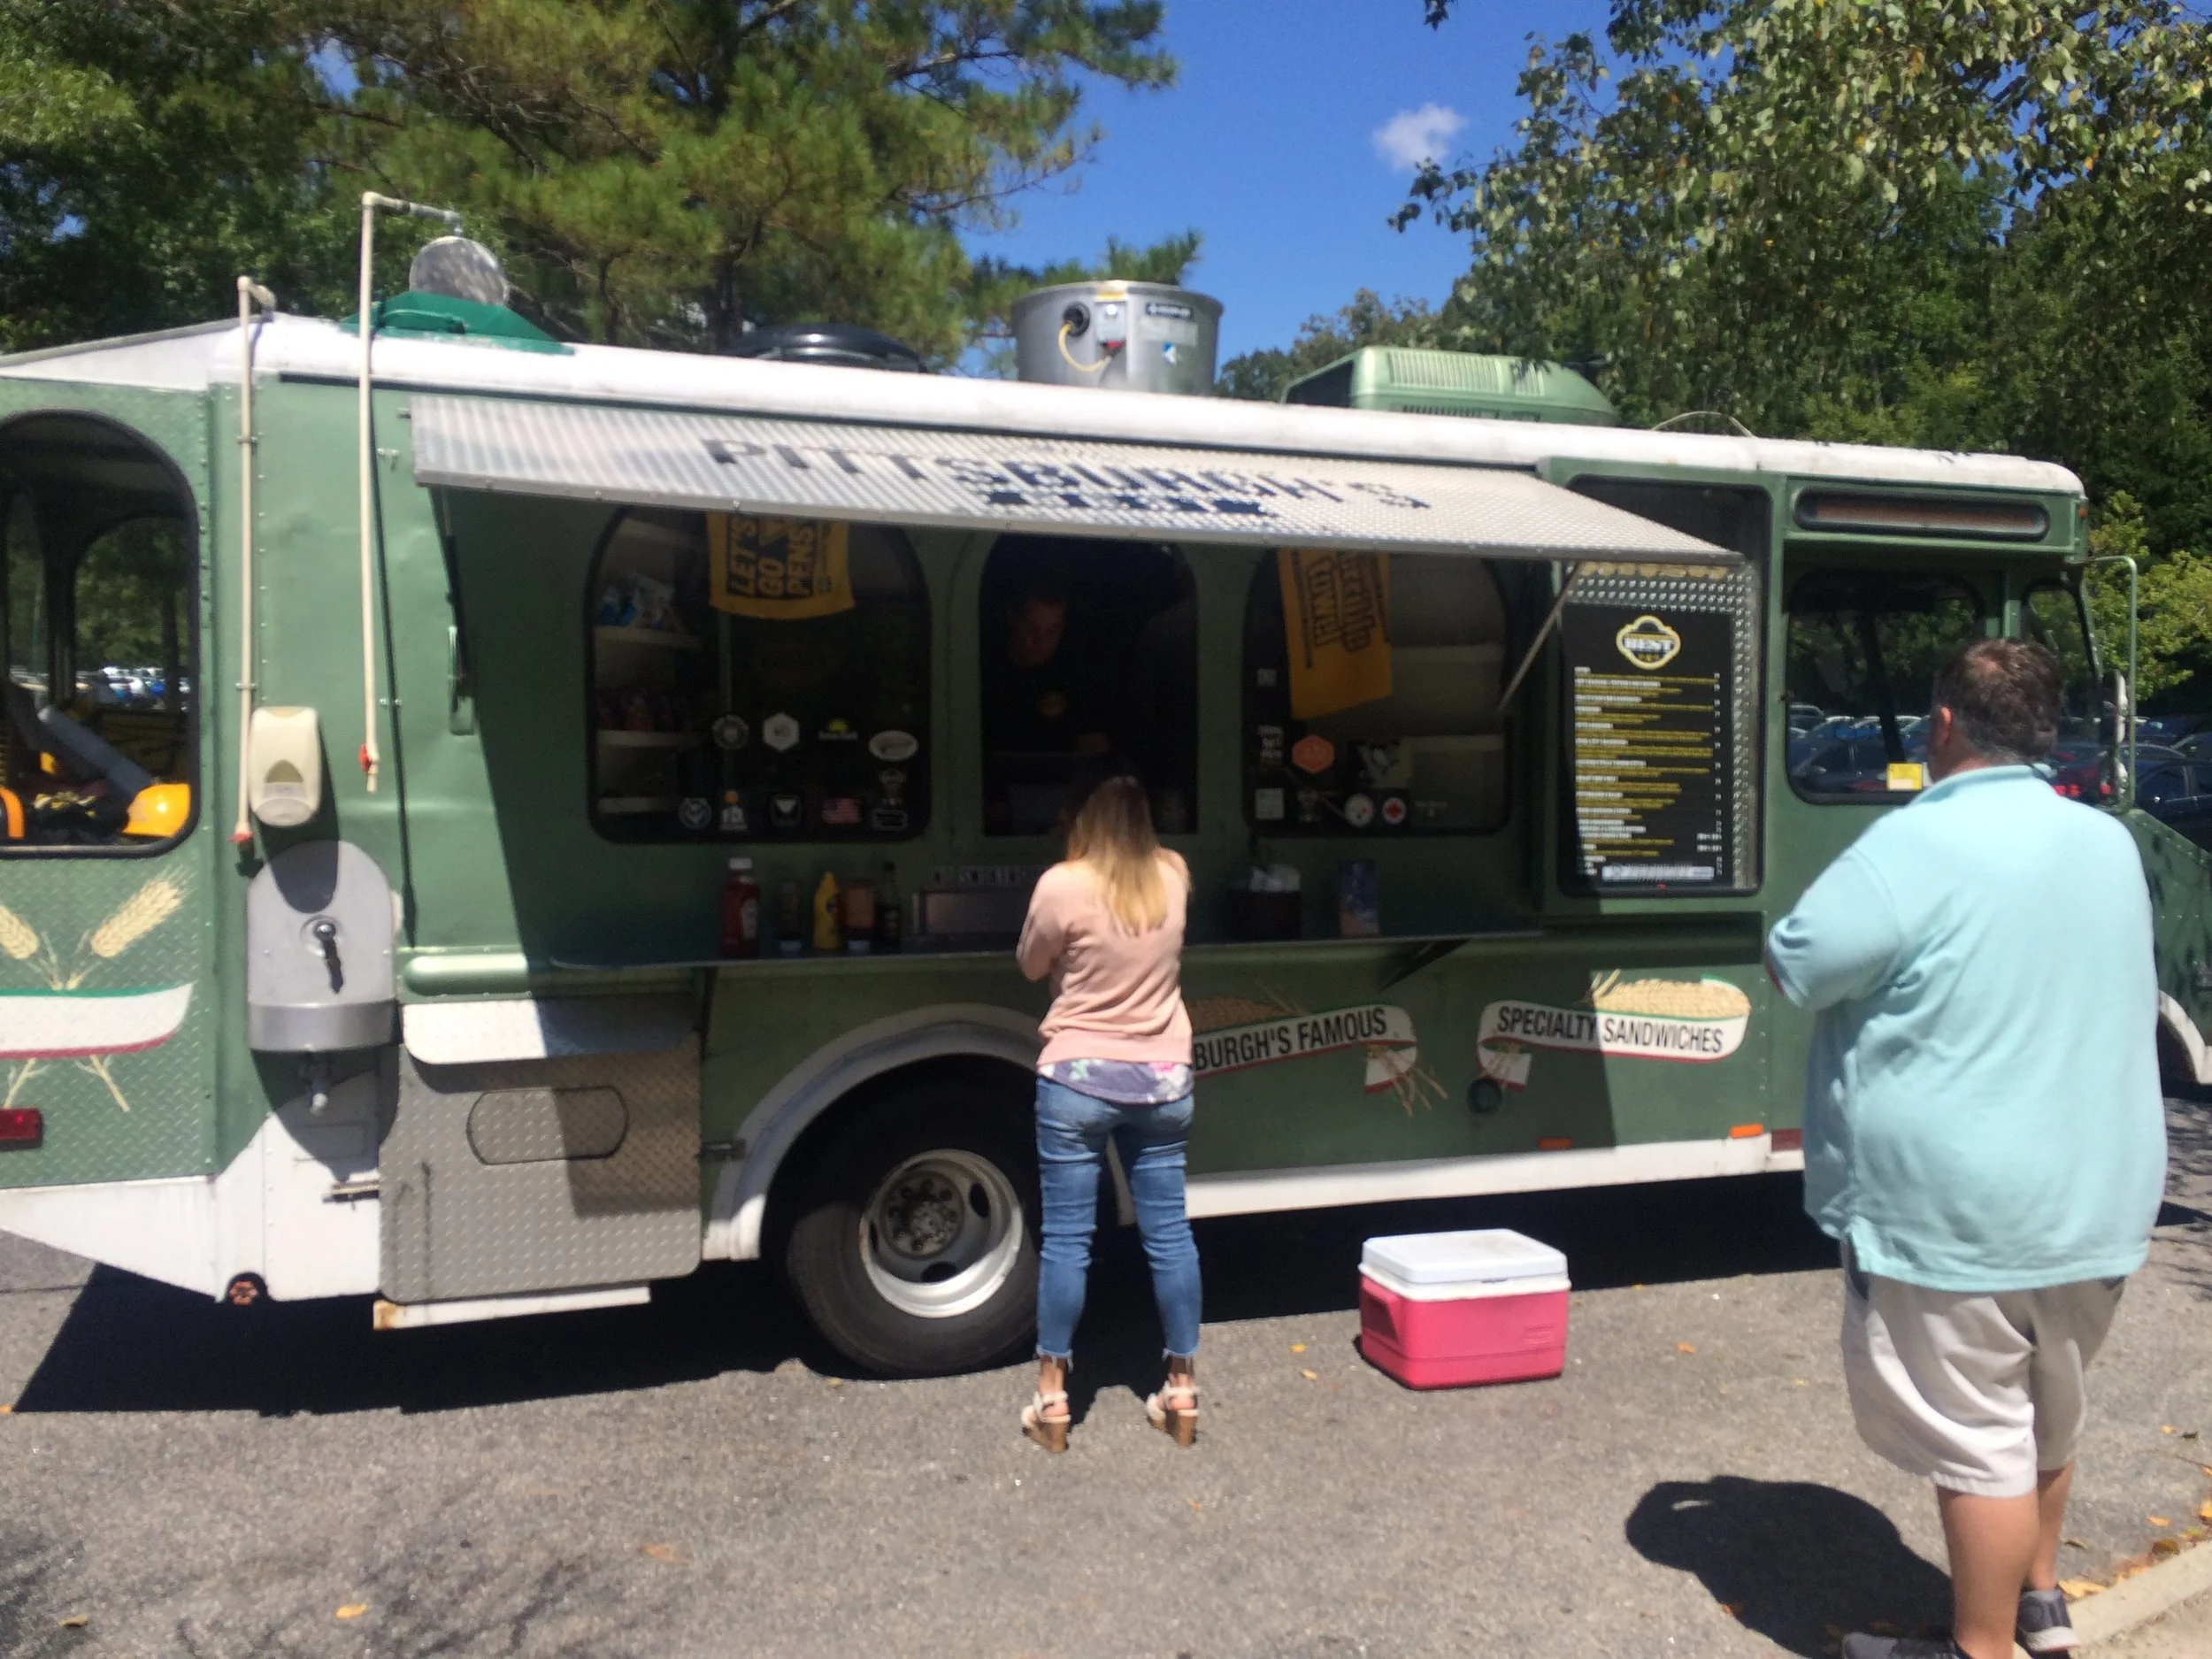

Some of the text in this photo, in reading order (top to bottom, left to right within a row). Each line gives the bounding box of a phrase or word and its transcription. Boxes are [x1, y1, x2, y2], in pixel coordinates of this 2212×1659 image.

[703, 439, 1432, 509] PITTSBURGH'S
[731, 517, 757, 595] LET'S
[758, 559, 785, 595] GO
[787, 526, 814, 595] PENS
[1297, 1007, 1387, 1050] FAMOUS
[1497, 1005, 1723, 1053] SPECIALTY SANDWICHES
